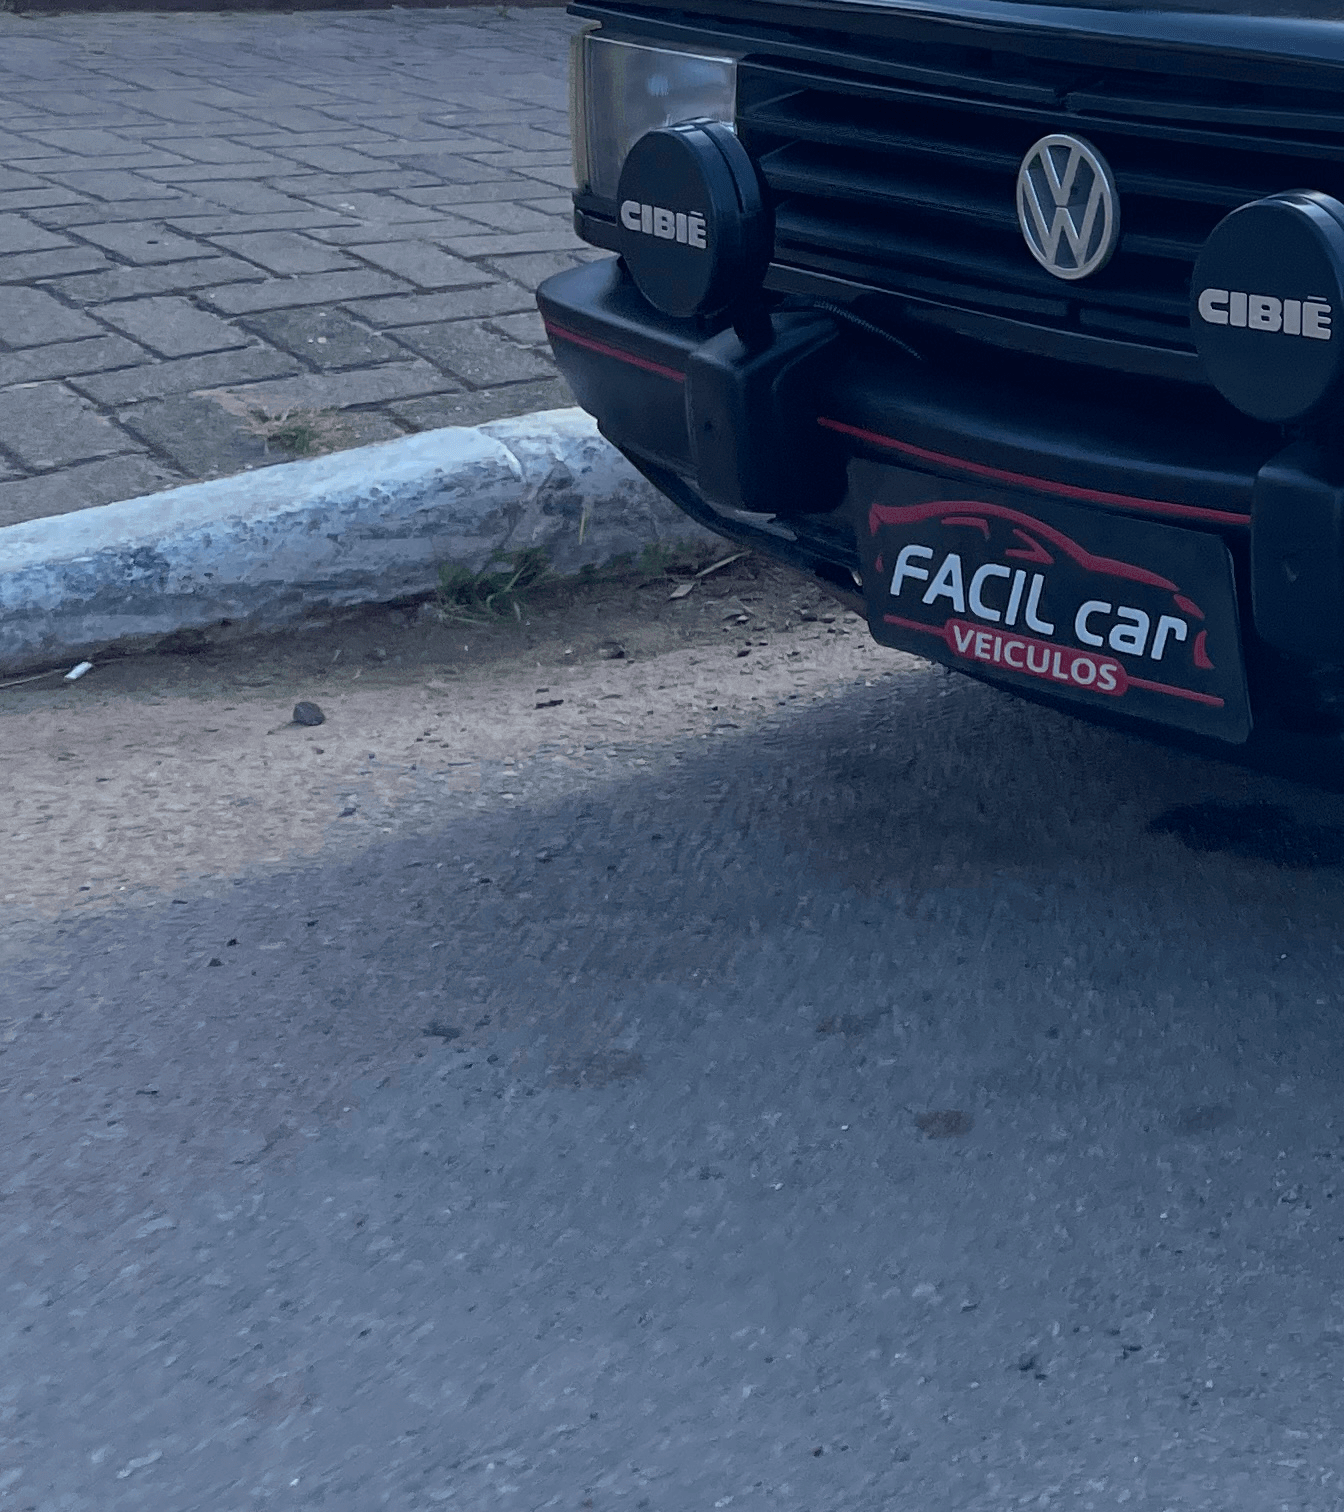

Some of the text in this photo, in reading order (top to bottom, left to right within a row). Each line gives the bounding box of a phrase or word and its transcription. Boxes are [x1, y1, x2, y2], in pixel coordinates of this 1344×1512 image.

[889, 544, 1188, 660] FACIL car
[953, 625, 1118, 691] VEICULOS
